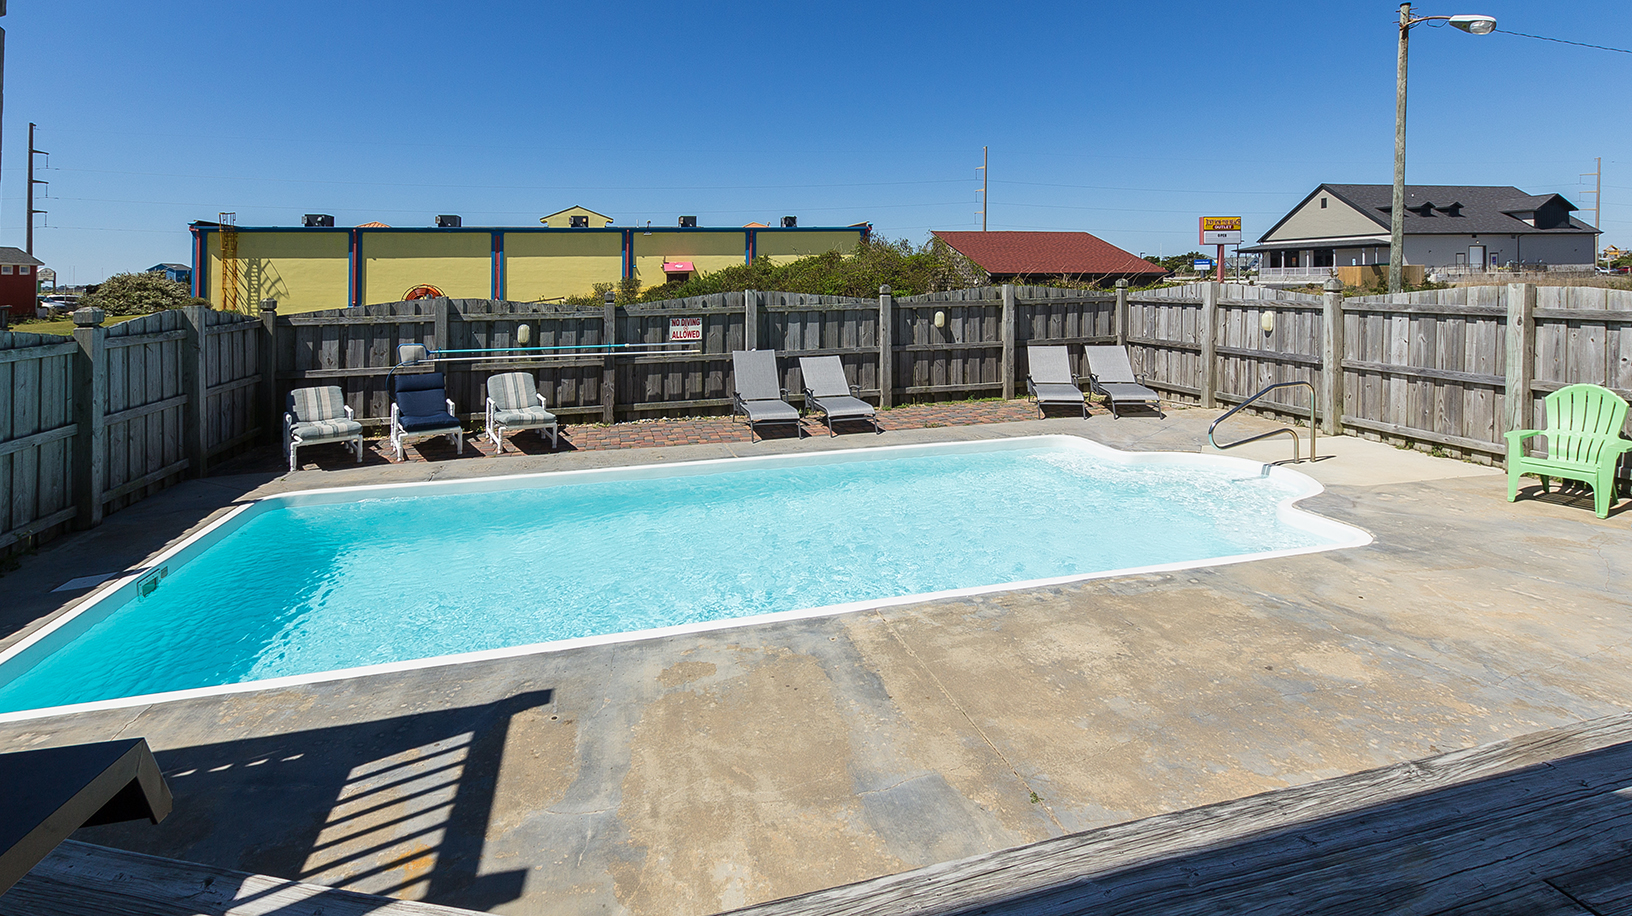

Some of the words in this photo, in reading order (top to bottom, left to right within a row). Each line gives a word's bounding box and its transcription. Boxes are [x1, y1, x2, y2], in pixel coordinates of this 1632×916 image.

[671, 318, 681, 326] NO
[681, 318, 700, 326] DIVING
[671, 330, 700, 339] ALLOWED
